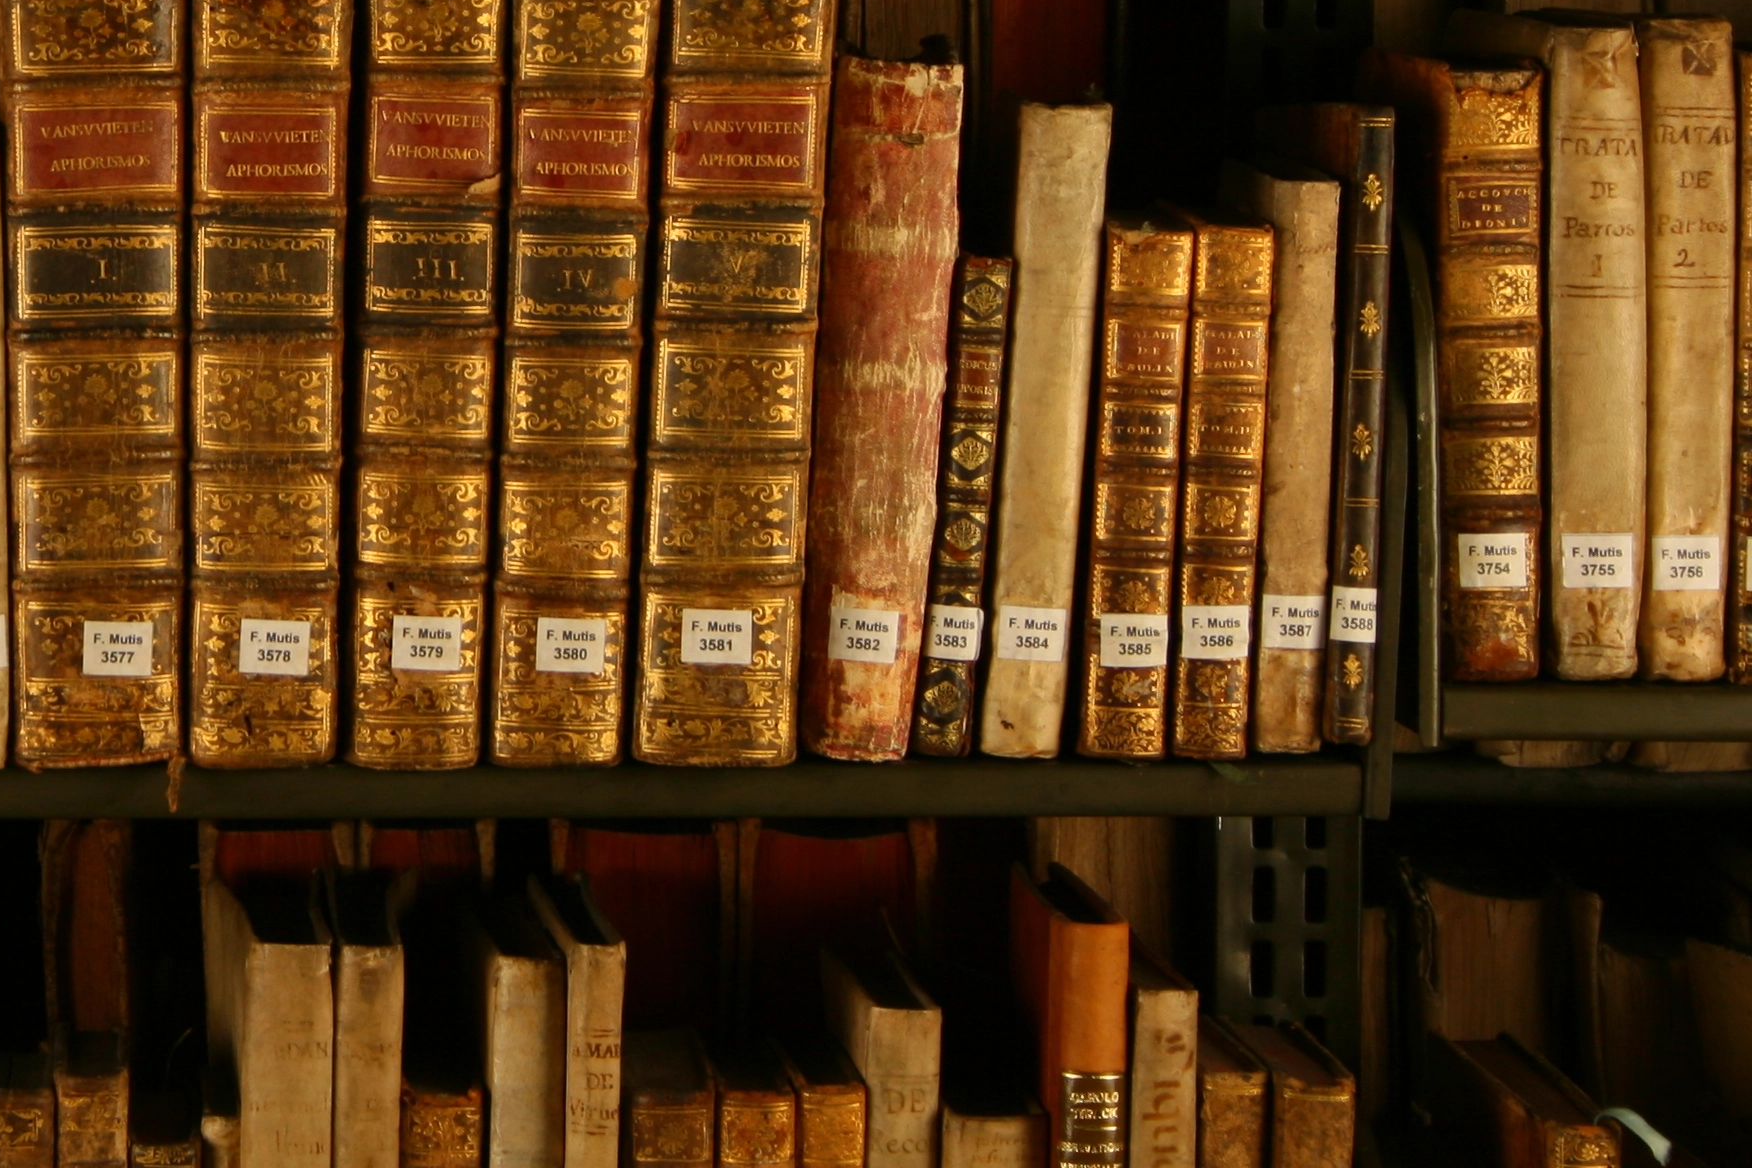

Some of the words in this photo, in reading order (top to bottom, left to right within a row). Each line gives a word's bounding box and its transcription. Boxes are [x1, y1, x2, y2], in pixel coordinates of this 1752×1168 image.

[385, 143, 487, 162] APHORISMOS
[50, 154, 151, 173] APHORISMOS
[698, 153, 802, 168] APHORISMOS
[225, 162, 329, 178] APHORISMOS
[534, 161, 637, 177] APHORISMOS
[1679, 169, 1713, 190] DE
[1589, 180, 1619, 201] DE
[1481, 202, 1503, 213] DE
[1672, 247, 1696, 269] 2
[1572, 546, 1584, 558] F.
[1588, 546, 1623, 558] Mutis
[1476, 562, 1511, 576] 3754
[1580, 563, 1616, 577] 3755
[1670, 565, 1704, 579] 3756
[1008, 617, 1020, 629] F.
[1024, 618, 1058, 632] Mutis
[1279, 623, 1312, 638] 3587
[1340, 616, 1374, 631] 3588
[93, 632, 105, 645] F.
[108, 633, 144, 646] Mutis
[698, 638, 733, 652] 3581
[846, 636, 881, 652] 3582
[934, 633, 968, 649] 3583
[1015, 635, 1050, 650] 3584
[1199, 634, 1234, 648] 3586
[257, 648, 292, 663] 3578
[409, 644, 445, 659] 3579
[553, 646, 588, 661] 3580
[1118, 642, 1152, 656] 3585
[100, 650, 136, 664] 3577
